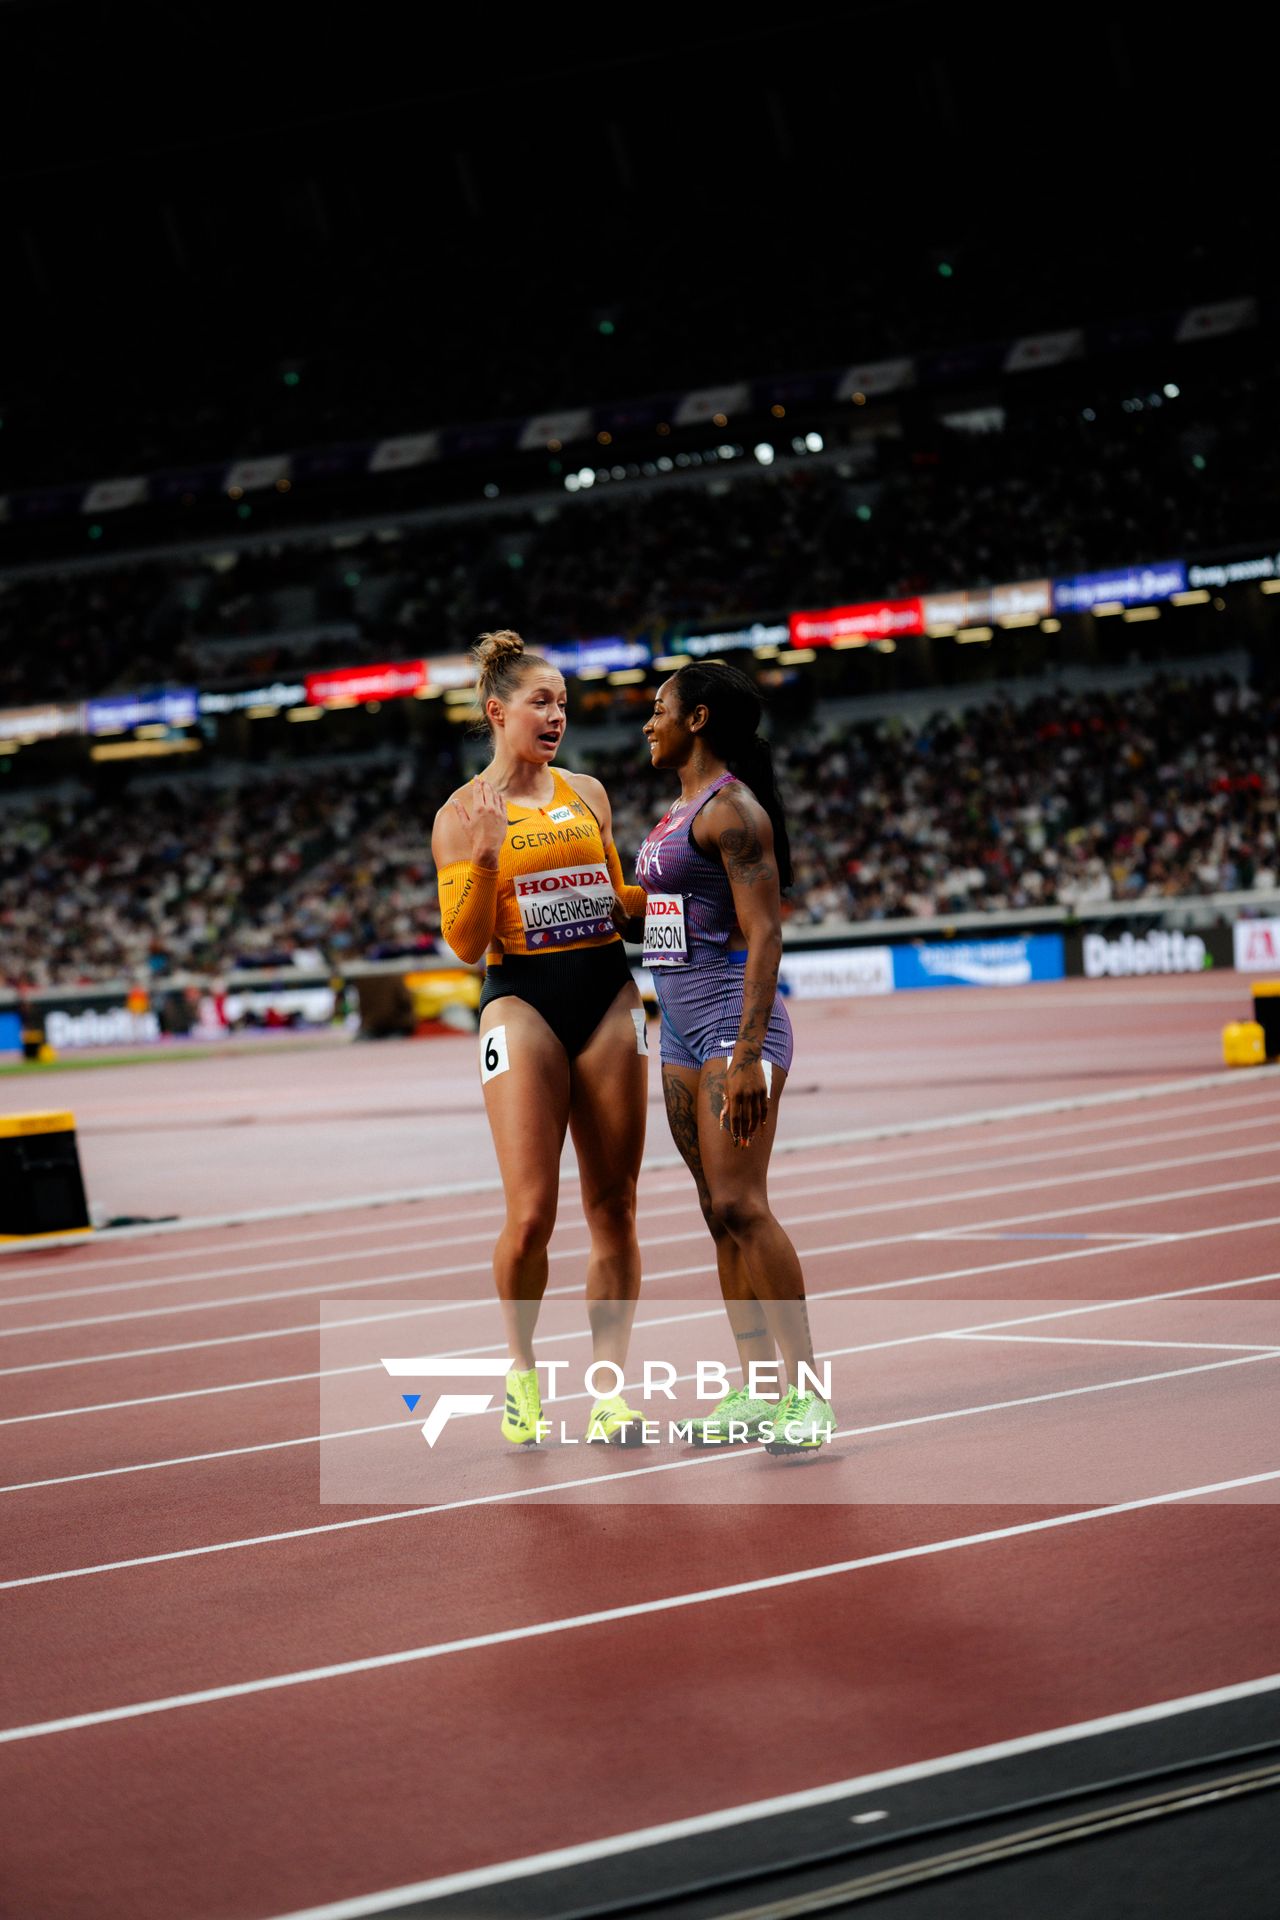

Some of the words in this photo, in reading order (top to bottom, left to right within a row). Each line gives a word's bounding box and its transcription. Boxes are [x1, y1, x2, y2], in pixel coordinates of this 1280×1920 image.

[511, 824, 595, 850] GERMANY
[518, 870, 609, 897] HONDA
[1083, 932, 1207, 978] Deloitte
[486, 1036, 499, 1072] 6
